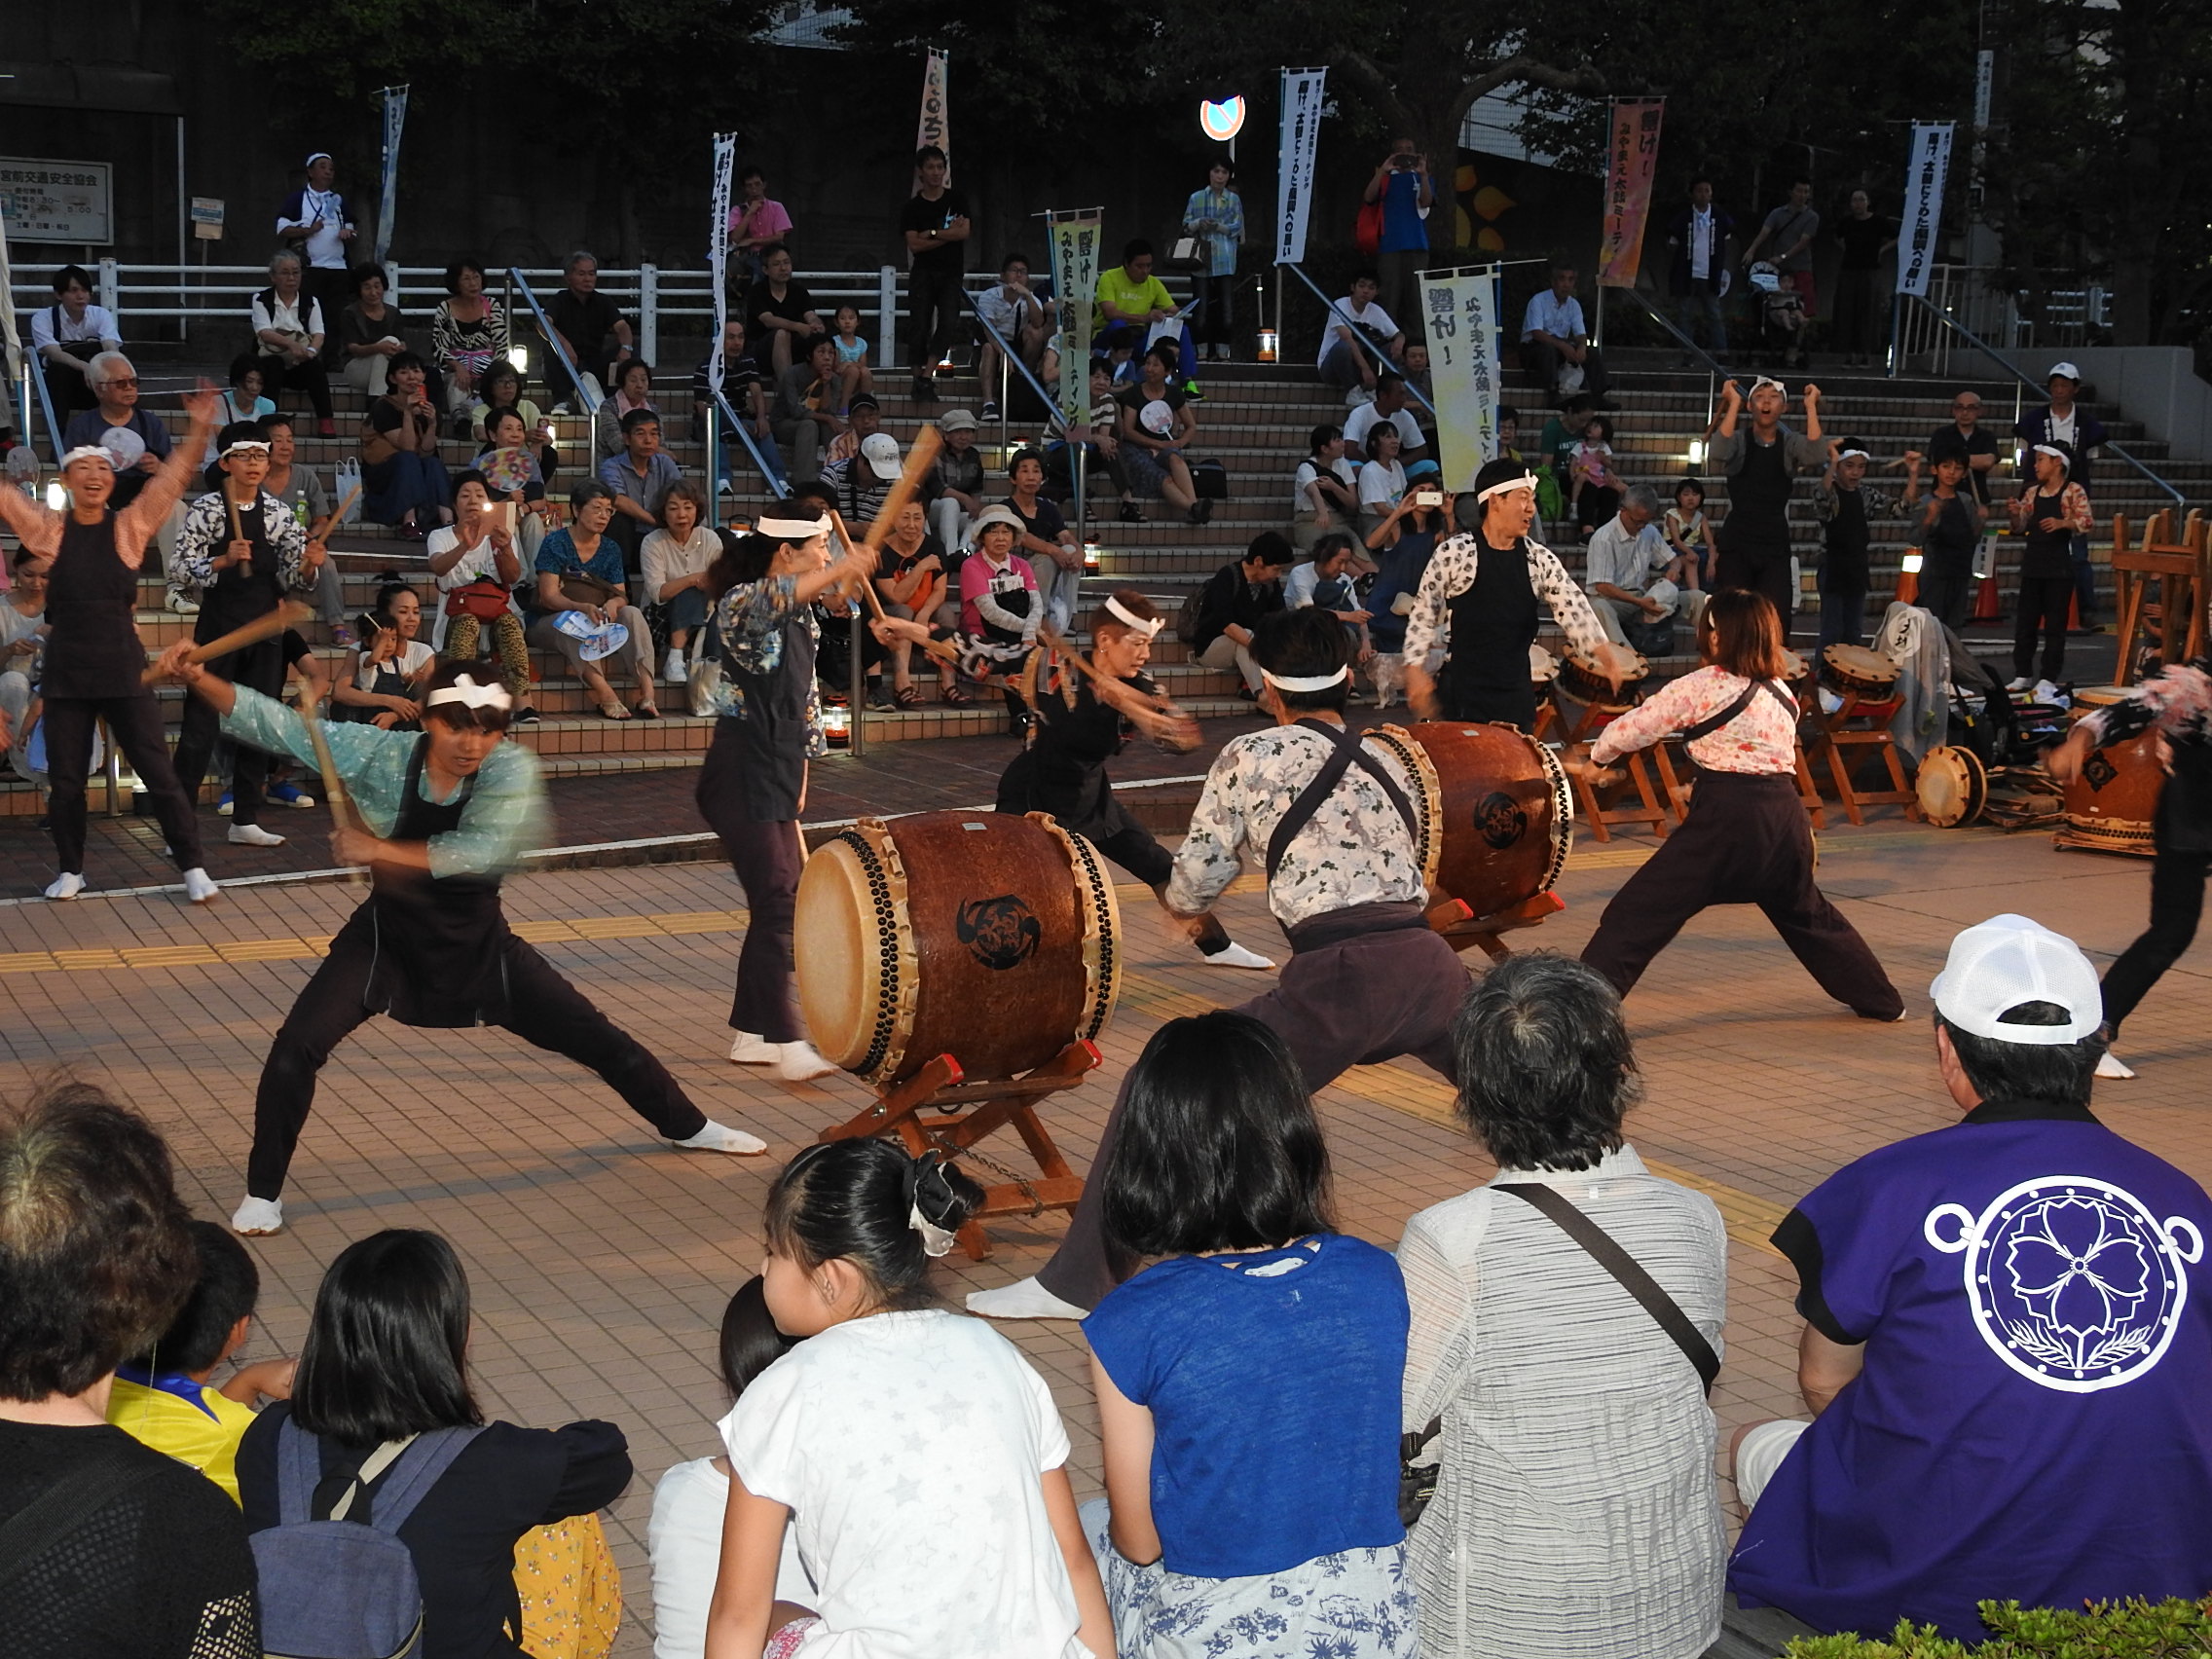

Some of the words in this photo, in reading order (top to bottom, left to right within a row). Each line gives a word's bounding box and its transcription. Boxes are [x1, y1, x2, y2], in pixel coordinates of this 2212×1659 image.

[1, 169, 97, 186] 宮前交通安全協会
